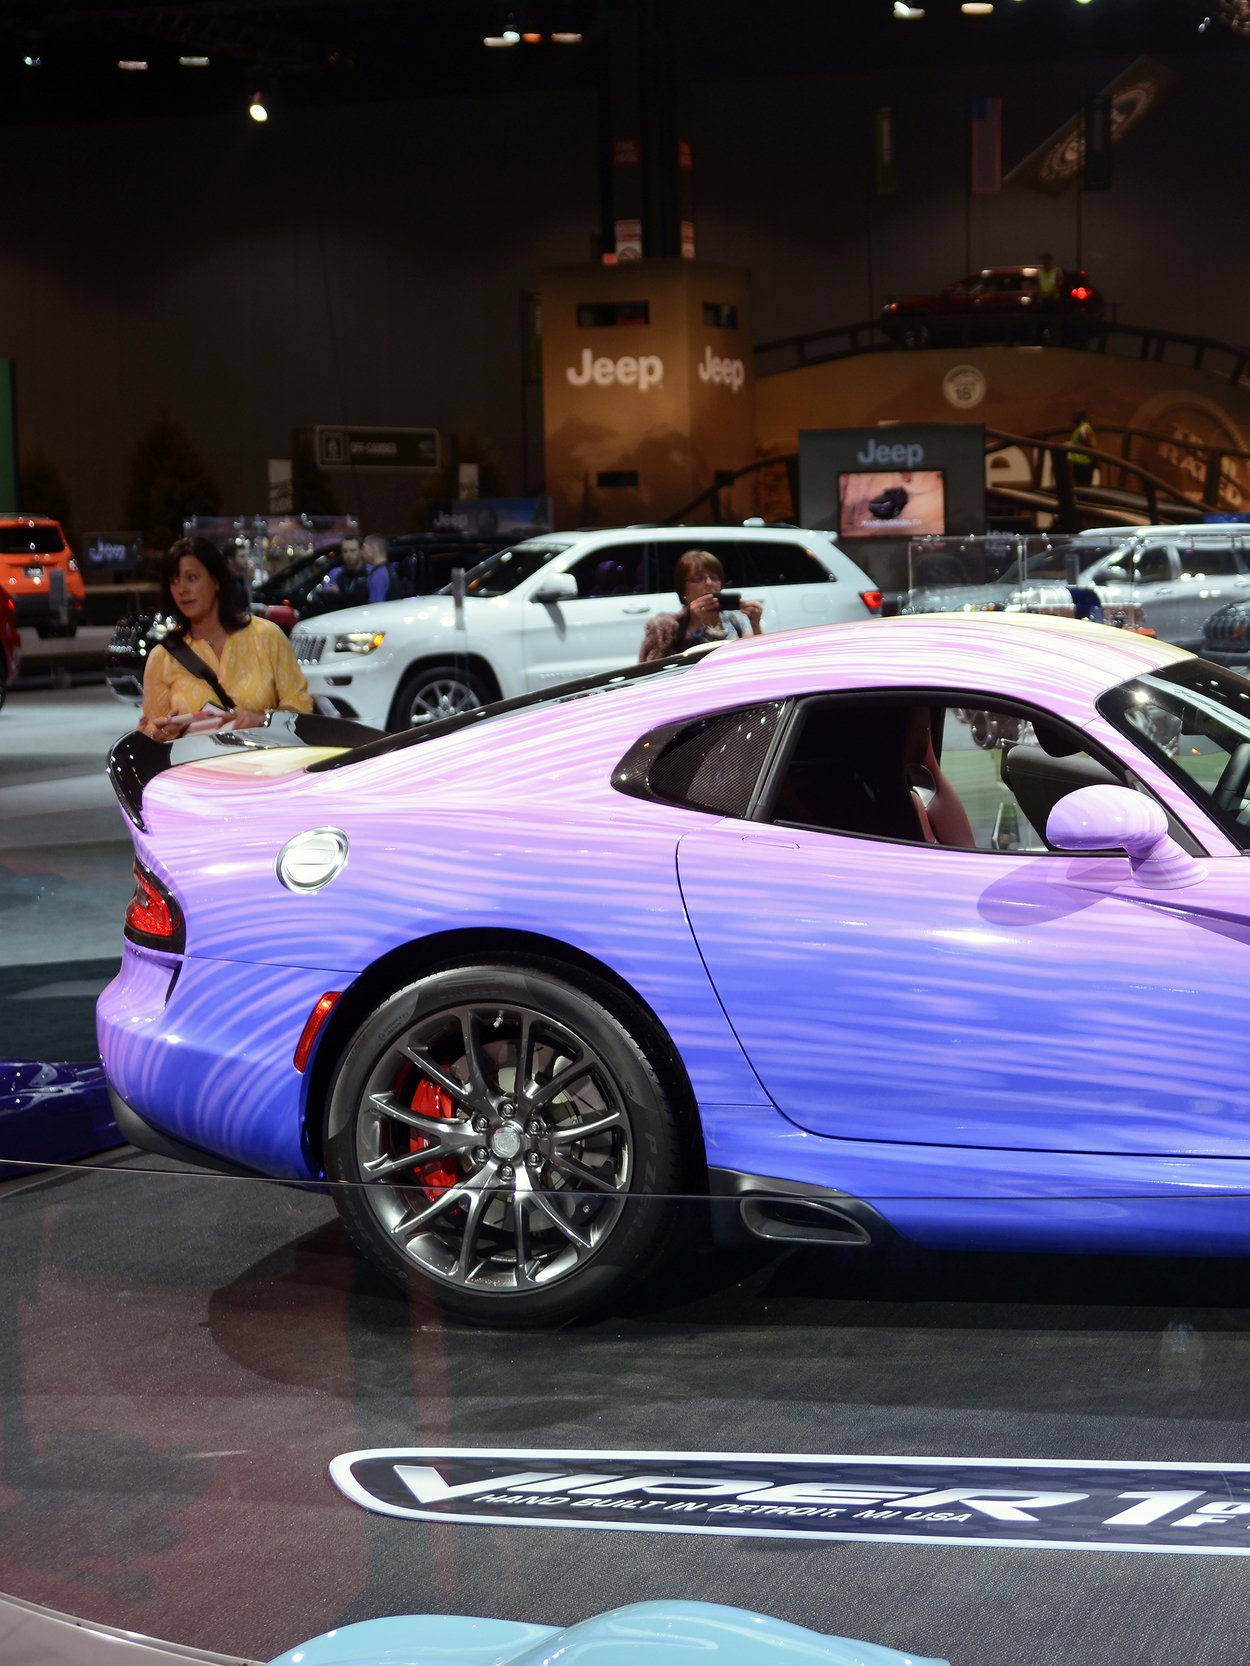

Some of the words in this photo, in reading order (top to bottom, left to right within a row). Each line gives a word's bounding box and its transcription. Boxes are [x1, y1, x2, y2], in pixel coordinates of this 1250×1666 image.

[566, 348, 664, 391] Jeep
[698, 345, 744, 392] Jeep
[857, 438, 924, 468] Jeep
[392, 1465, 1091, 1522] VIPER
[1101, 1490, 1208, 1525] 1
[473, 1494, 571, 1506] HAND
[570, 1498, 668, 1510] BUILT
[664, 1502, 709, 1511] IN
[852, 1509, 902, 1519] MI
[903, 1512, 972, 1523] USA
